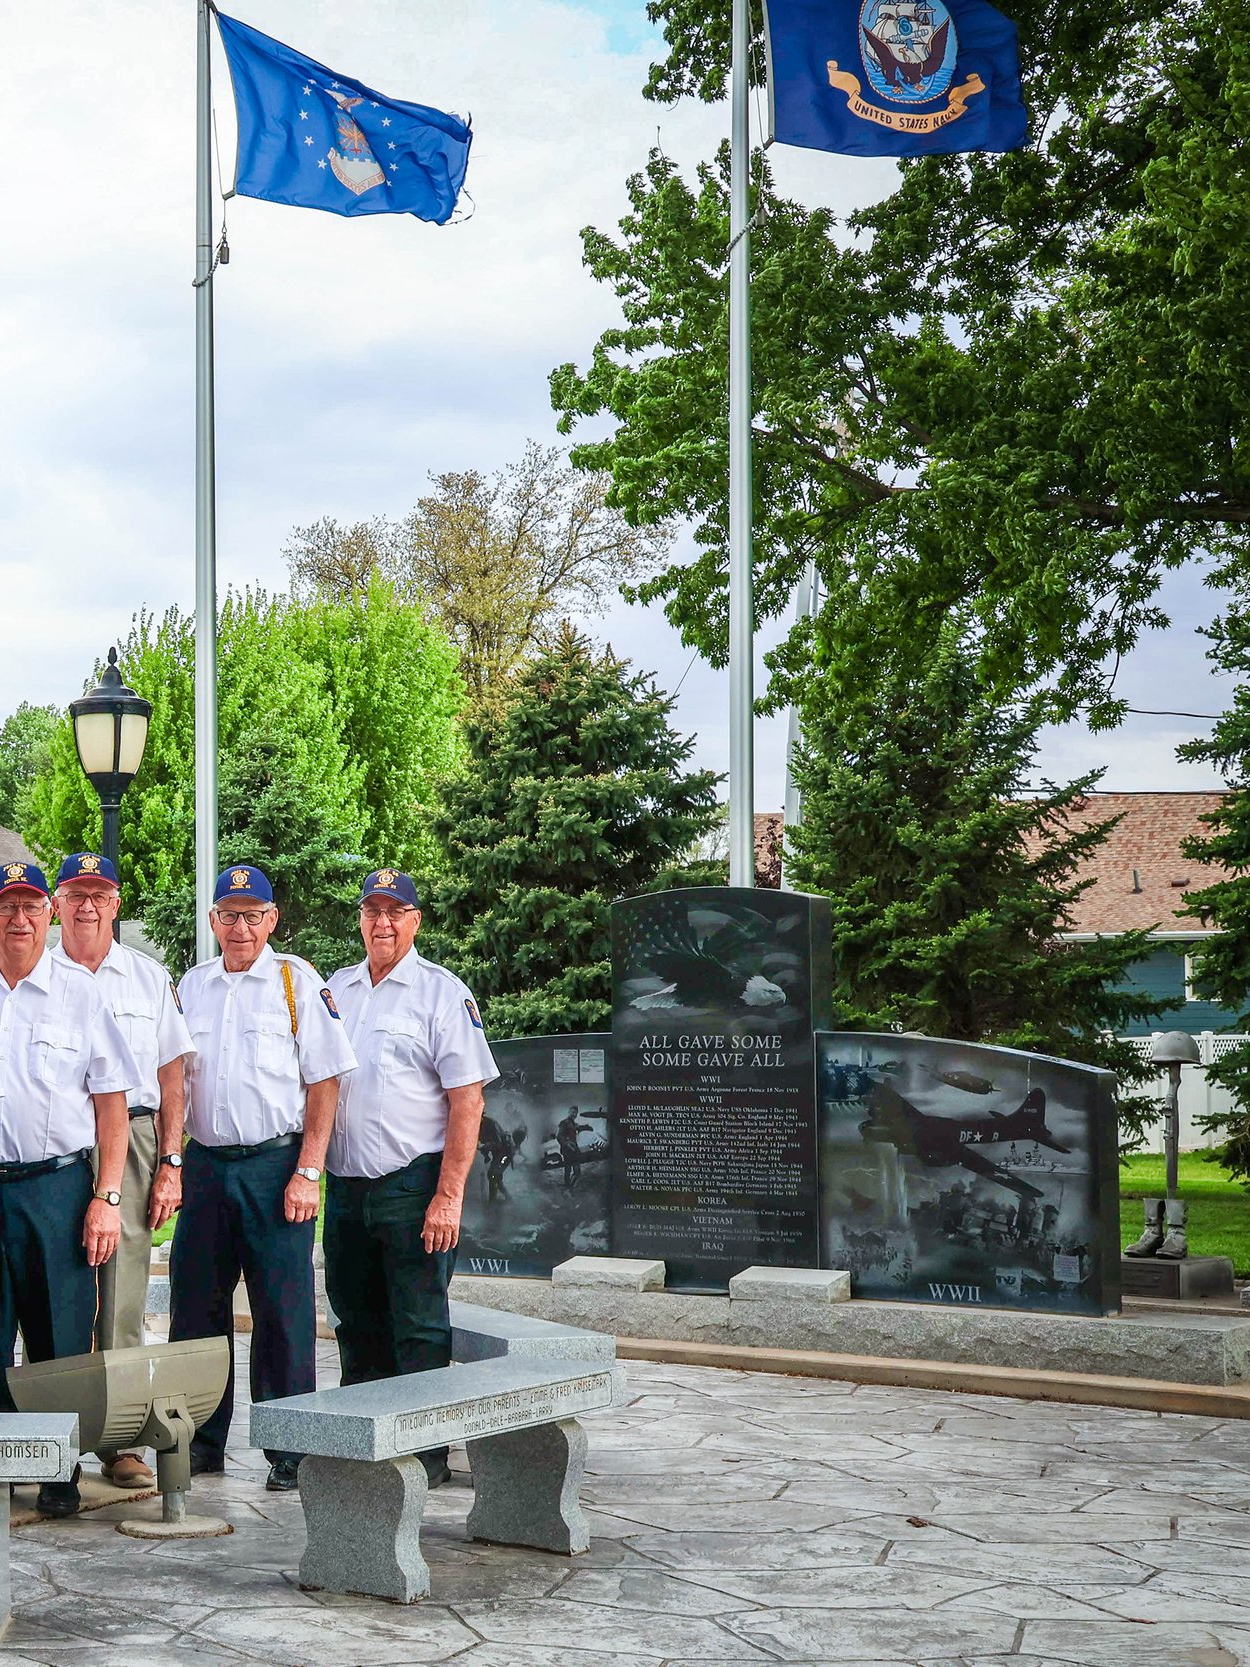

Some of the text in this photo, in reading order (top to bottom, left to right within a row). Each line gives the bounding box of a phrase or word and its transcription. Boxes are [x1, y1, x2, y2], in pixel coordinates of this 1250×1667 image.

[854, 100, 892, 125] UNITED
[899, 116, 928, 130] STATES
[639, 1035, 782, 1050] ALL GAVE SOME
[642, 1053, 786, 1067] SOME GAVE ALL
[700, 1076, 721, 1084] WWI
[699, 1095, 723, 1104] WWII
[959, 1131, 973, 1143] DF
[697, 1196, 727, 1205] KOREA
[692, 1216, 733, 1225] VIETNAM
[702, 1242, 724, 1251] IRAQ
[470, 1258, 510, 1274] WWI
[927, 1282, 982, 1303] WWII
[409, 1413, 434, 1430] LOVING
[436, 1407, 465, 1424] MEMORY
[467, 1404, 475, 1418] OF
[478, 1401, 491, 1415] OUR
[493, 1395, 521, 1411] PARENTS
[557, 1384, 572, 1398] FRED
